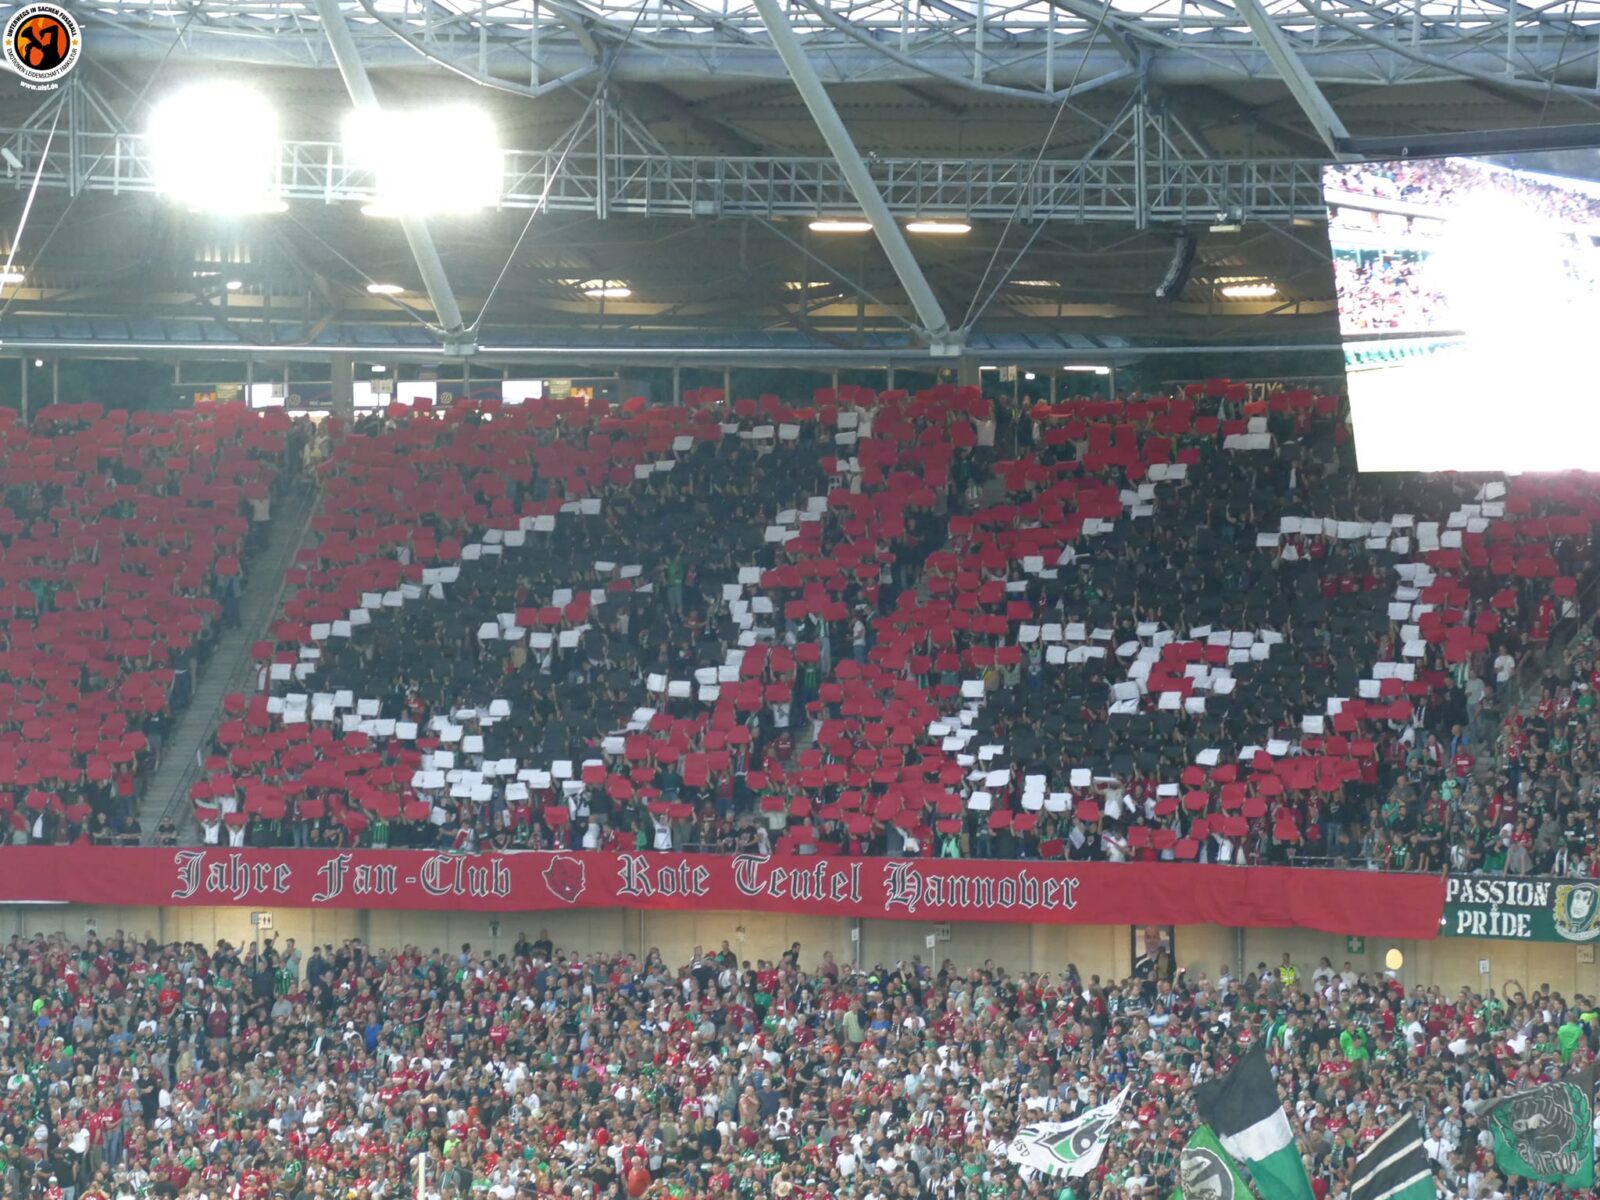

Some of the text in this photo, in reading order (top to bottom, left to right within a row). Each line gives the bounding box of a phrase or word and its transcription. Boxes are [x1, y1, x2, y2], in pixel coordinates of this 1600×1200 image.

[171, 850, 292, 901] Jahre
[616, 853, 710, 897] Rote
[731, 854, 863, 903] Teufel
[883, 861, 1080, 913] Hannover
[1446, 878, 1551, 906] PASSION
[1456, 910, 1531, 937] PRIDE
